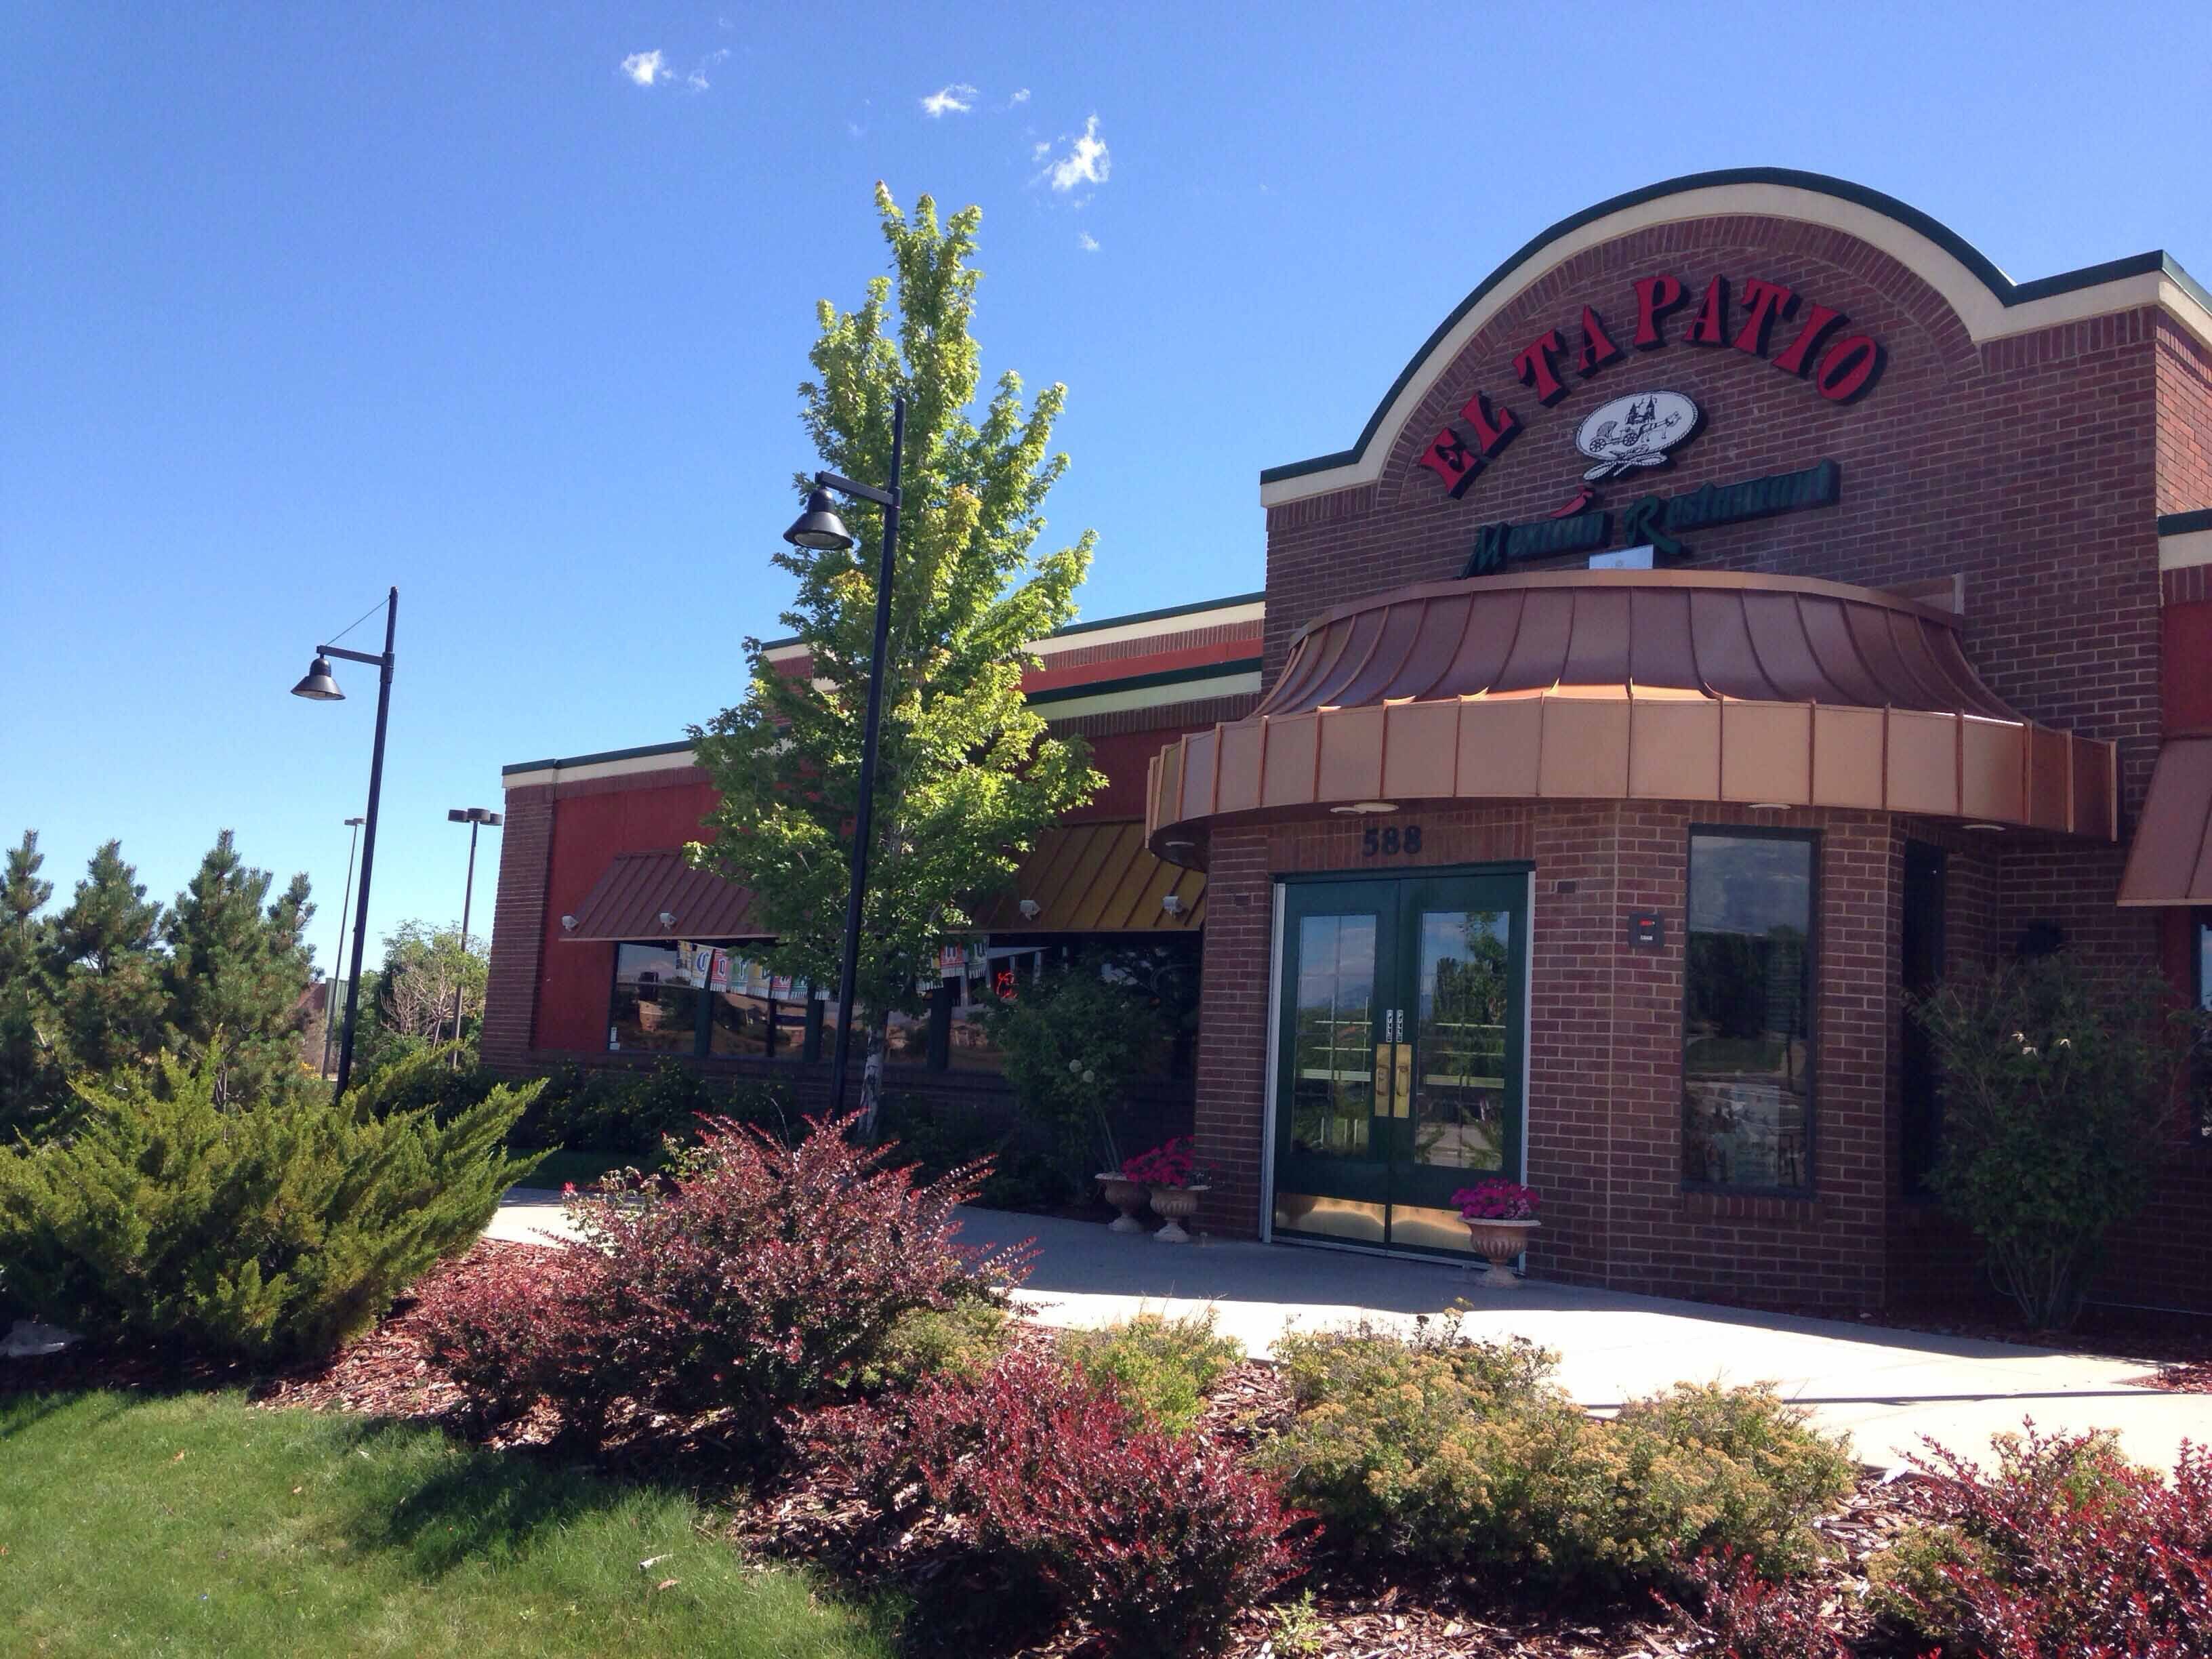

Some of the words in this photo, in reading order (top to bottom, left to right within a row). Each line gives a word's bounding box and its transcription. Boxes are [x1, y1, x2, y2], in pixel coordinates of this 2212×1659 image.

[1421, 392, 1518, 496] EL
[1624, 459, 1838, 554] Restaurant
[1363, 826, 1421, 856] 588
